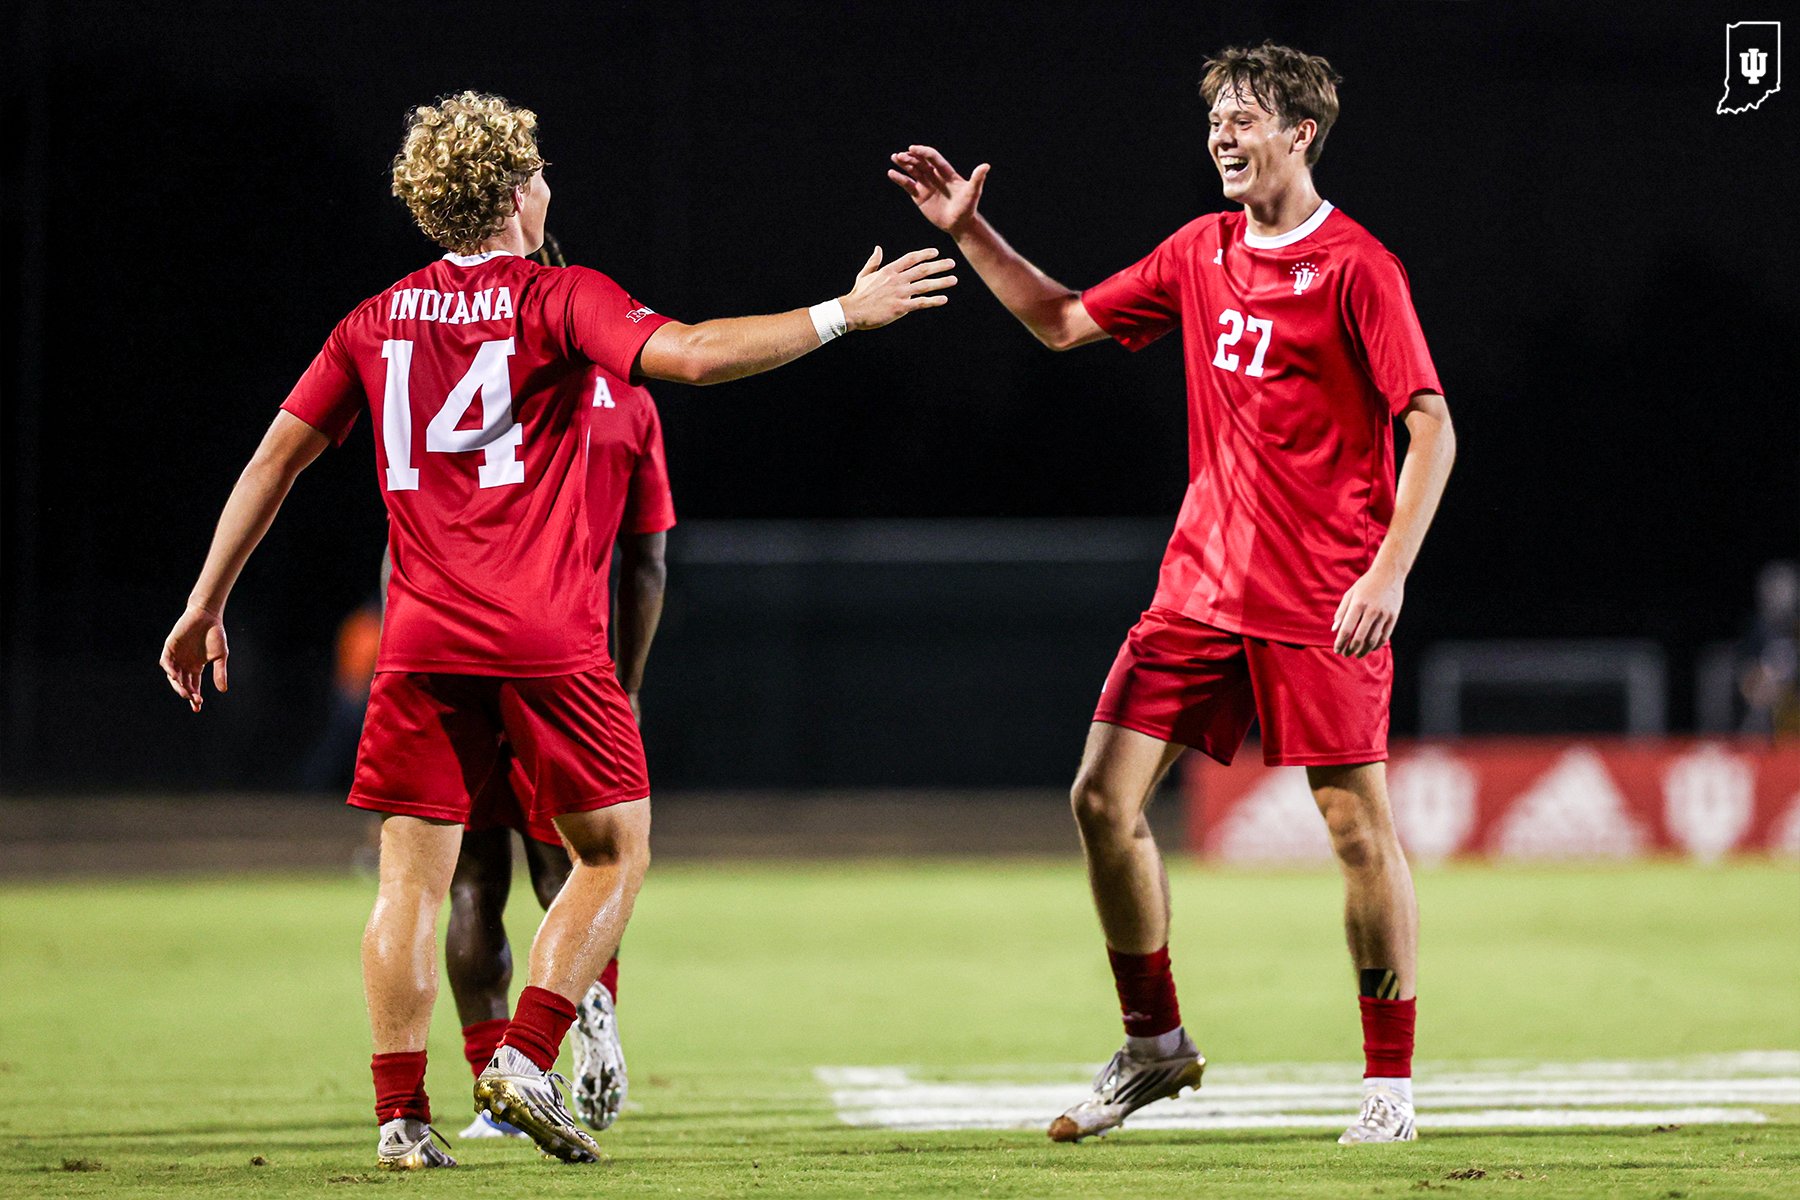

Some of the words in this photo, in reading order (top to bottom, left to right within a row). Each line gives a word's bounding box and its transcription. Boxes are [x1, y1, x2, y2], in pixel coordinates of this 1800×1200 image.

[389, 286, 514, 325] INDIANA
[1212, 308, 1274, 378] 27
[381, 336, 525, 492] 14
